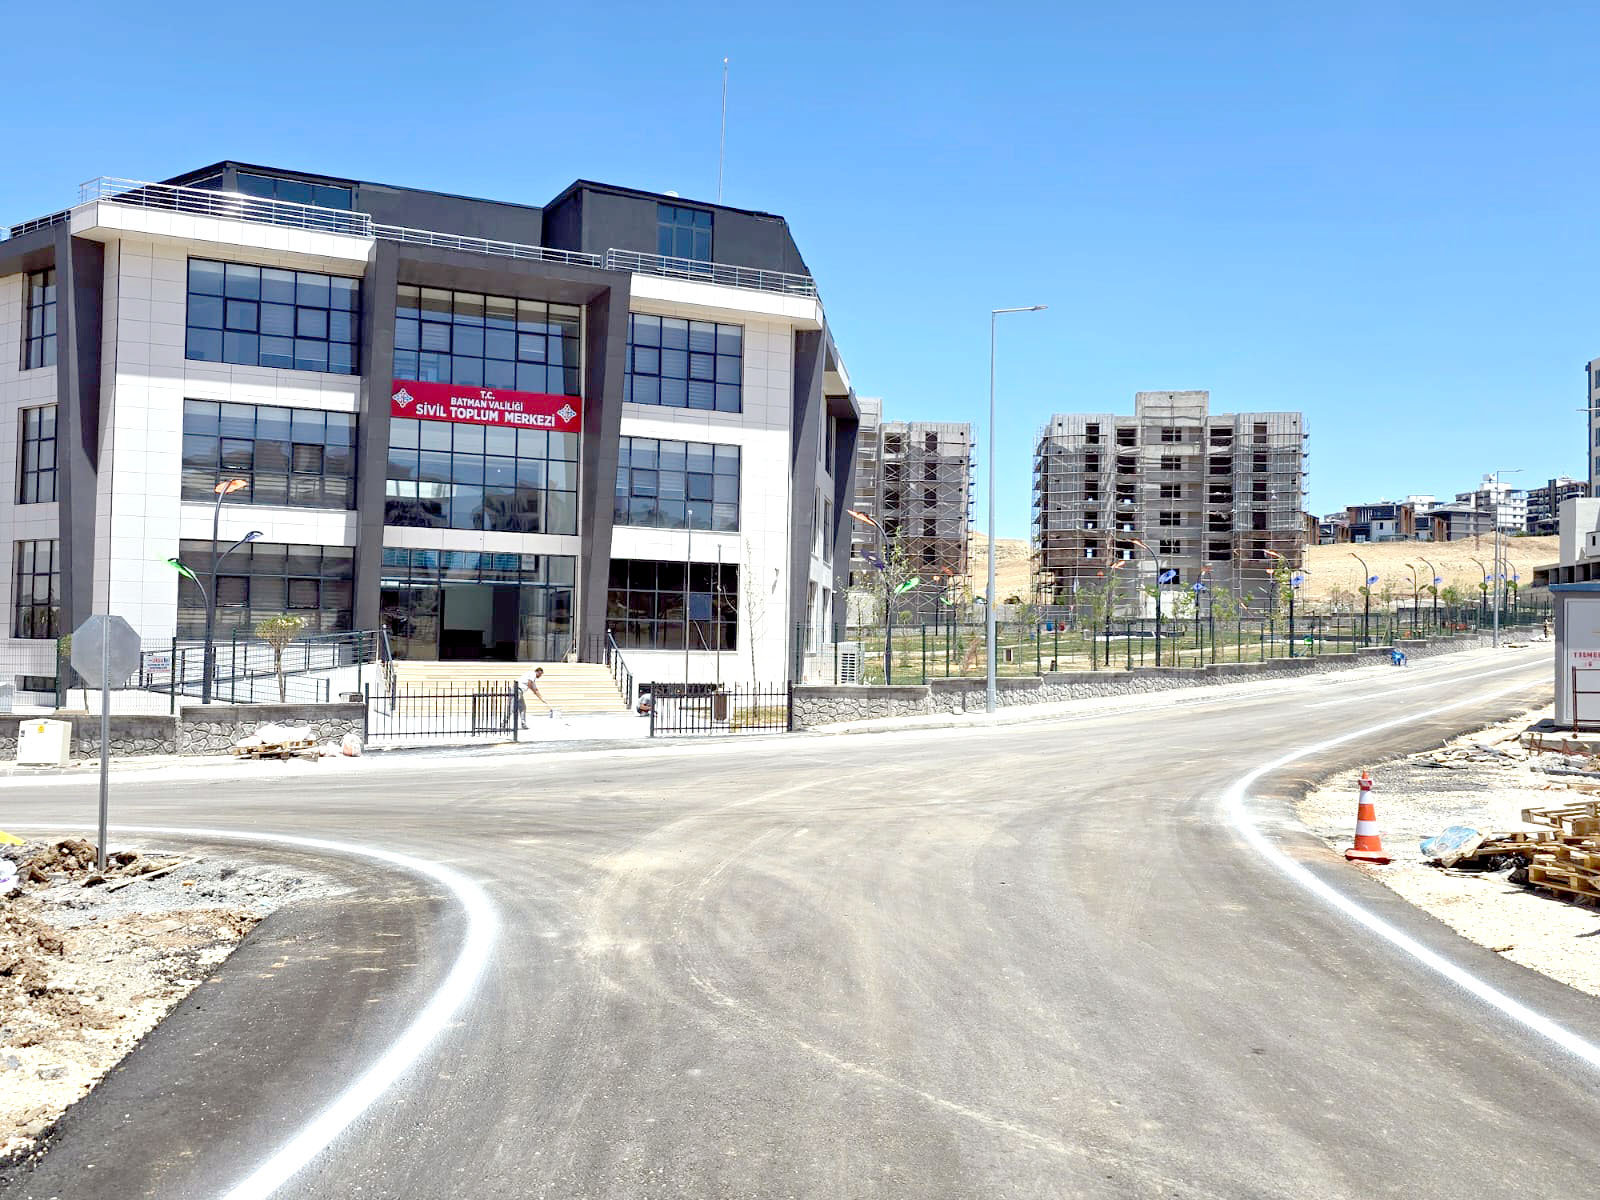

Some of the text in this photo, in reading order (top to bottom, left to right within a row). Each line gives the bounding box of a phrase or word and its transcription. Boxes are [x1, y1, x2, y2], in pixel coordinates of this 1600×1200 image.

[480, 390, 495, 400] T.C.
[450, 397, 487, 408] BATMAN
[415, 401, 555, 427] SİVİL TOPLUM MERKEZİ
